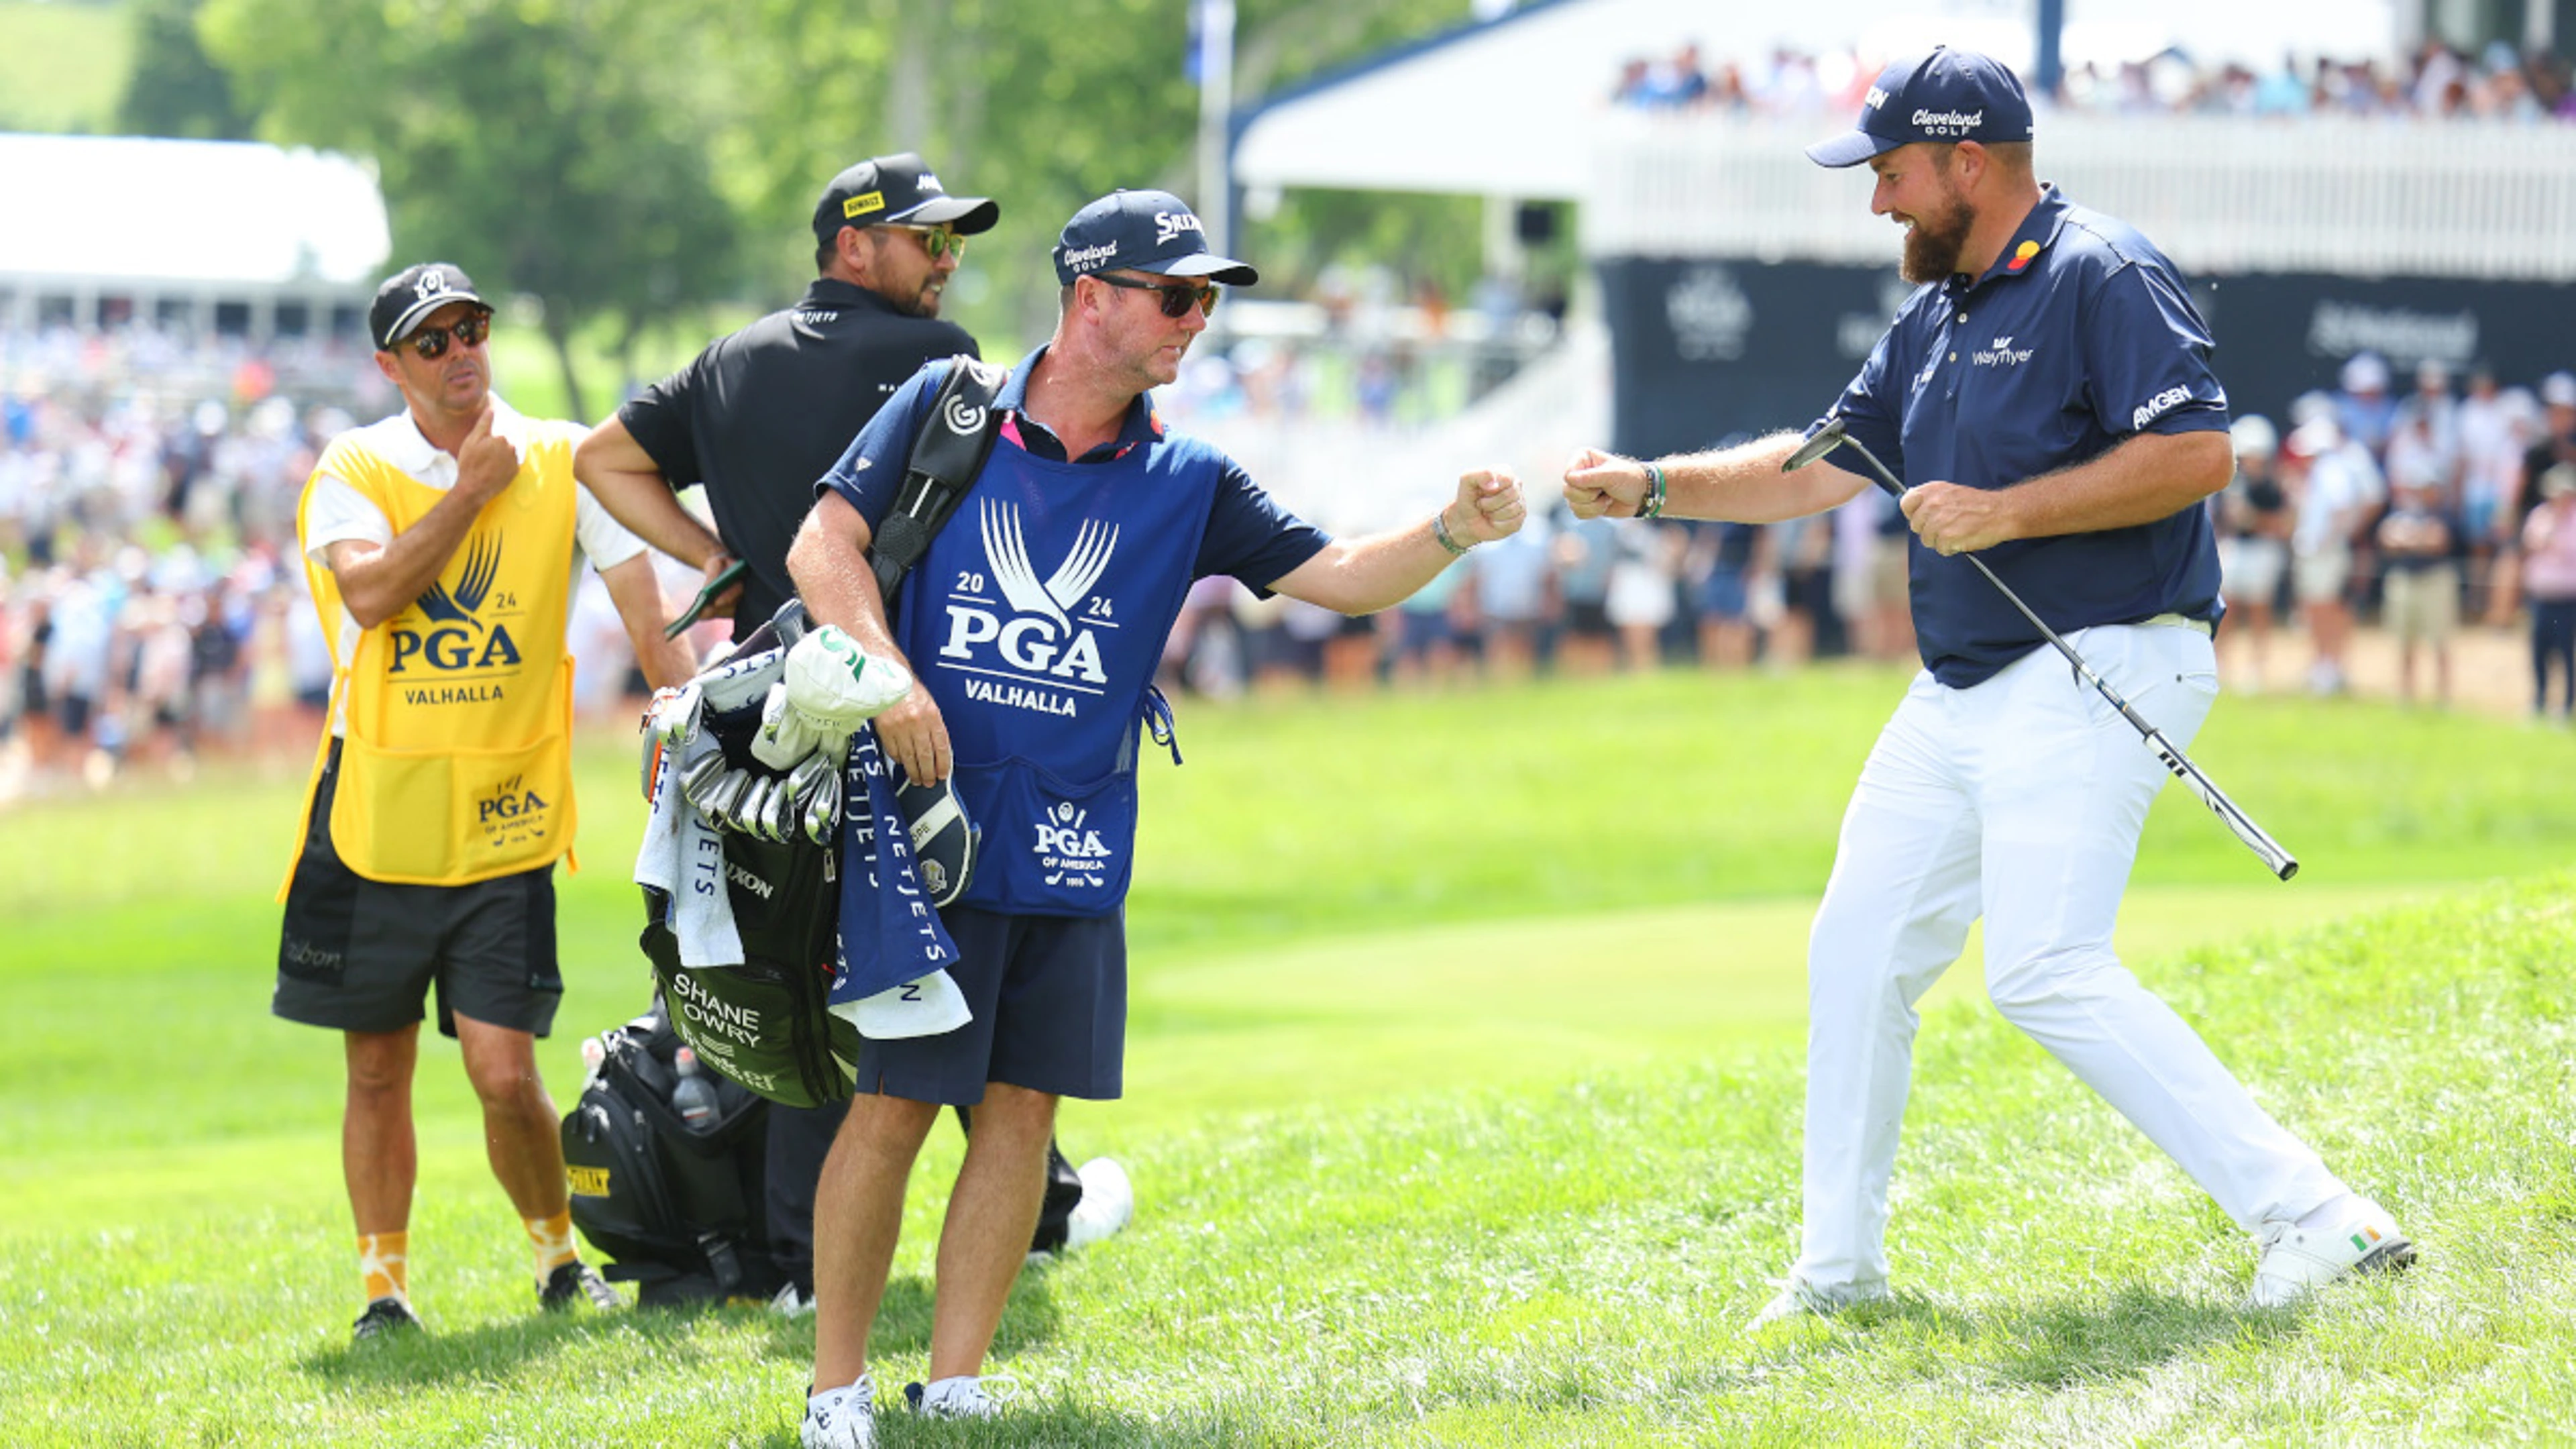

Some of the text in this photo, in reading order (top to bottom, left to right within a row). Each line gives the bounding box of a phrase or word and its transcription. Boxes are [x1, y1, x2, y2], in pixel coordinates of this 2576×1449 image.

[1912, 109, 1982, 126] Cleveland
[1925, 126, 1970, 136] GOLF
[1065, 239, 1117, 267] Cleveland
[1073, 257, 1107, 274] GOLF
[1972, 347, 2033, 368] Wayflyer
[2133, 383, 2193, 431] AMGEN
[957, 571, 984, 594] 20
[496, 592, 517, 608] 24
[1088, 596, 1113, 618] 24
[388, 624, 522, 674] PGA
[939, 604, 1108, 684] PGA
[405, 684, 504, 706] VALHALLA
[965, 678, 1077, 718] VALHALLA
[479, 790, 549, 823] PGA
[1032, 823, 1112, 857] PGA
[1042, 856, 1106, 870] OF AMERICA
[724, 859, 774, 900] IXON
[883, 815, 947, 961] NETJETS
[674, 973, 761, 1031] SHANE
